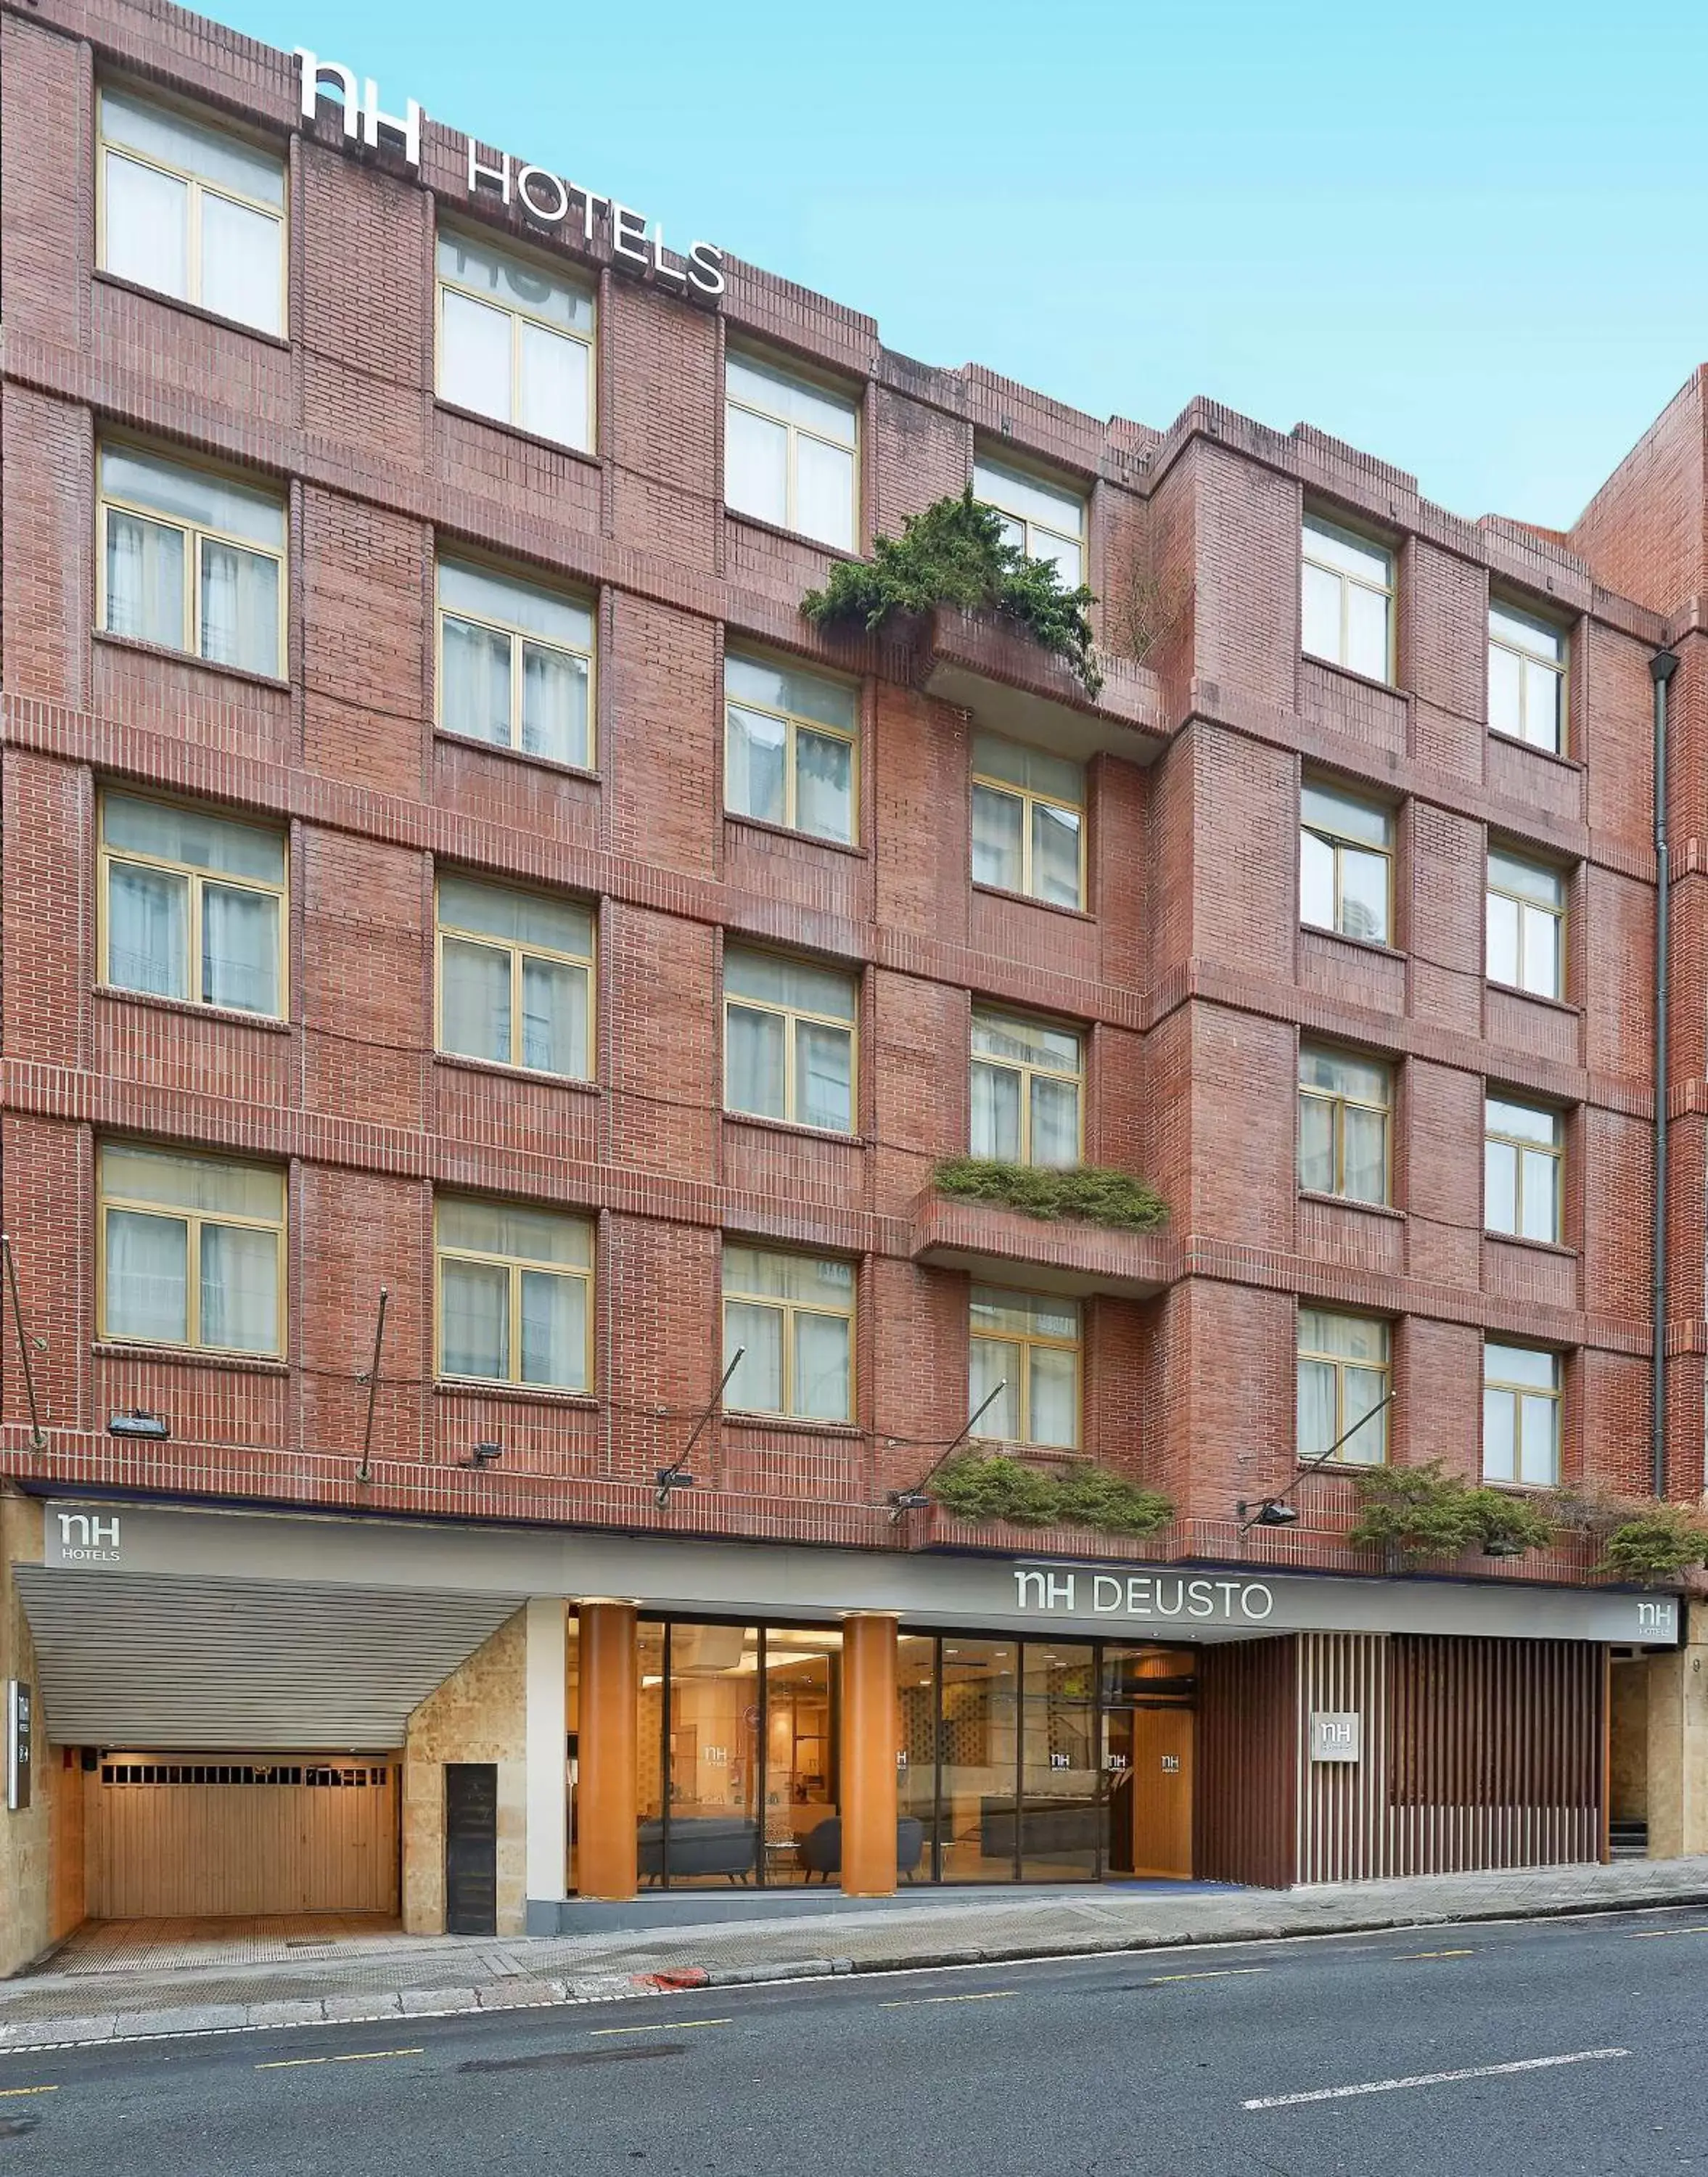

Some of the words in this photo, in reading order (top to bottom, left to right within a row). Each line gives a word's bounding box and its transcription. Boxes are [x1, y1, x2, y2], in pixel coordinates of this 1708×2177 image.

[468, 138, 725, 294] HOTELS
[62, 1548, 120, 1561] HOTELS
[1093, 1575, 1273, 1619] DEUSTO
